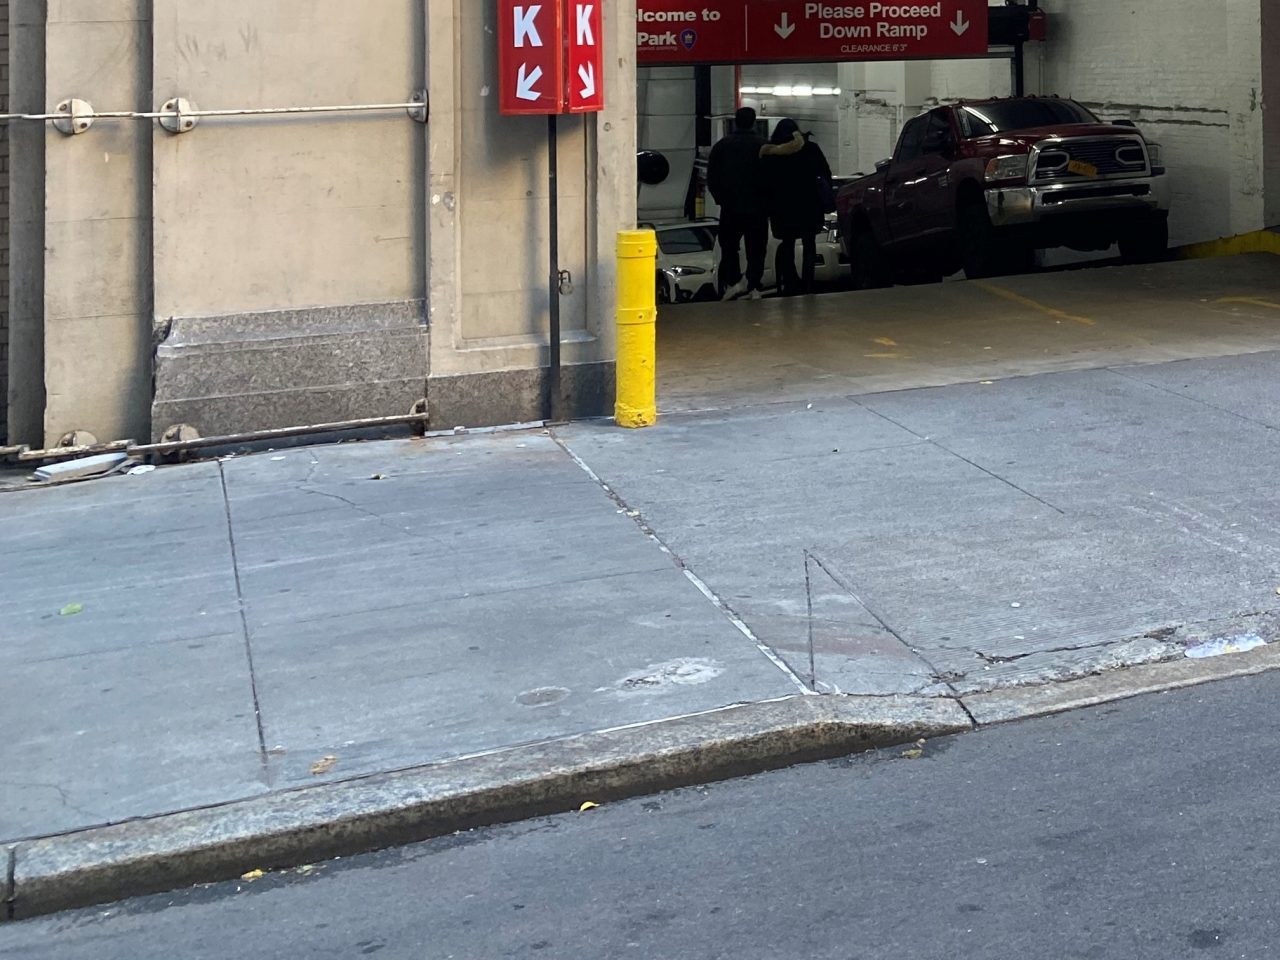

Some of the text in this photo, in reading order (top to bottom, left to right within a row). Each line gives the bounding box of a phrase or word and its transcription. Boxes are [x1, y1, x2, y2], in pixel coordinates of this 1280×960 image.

[637, 7, 721, 22] lcome to
[805, 2, 941, 19] Please Proceed
[637, 31, 677, 45] Park
[820, 21, 928, 40] Down Ramp
[841, 43, 891, 52] CLEARANCE
